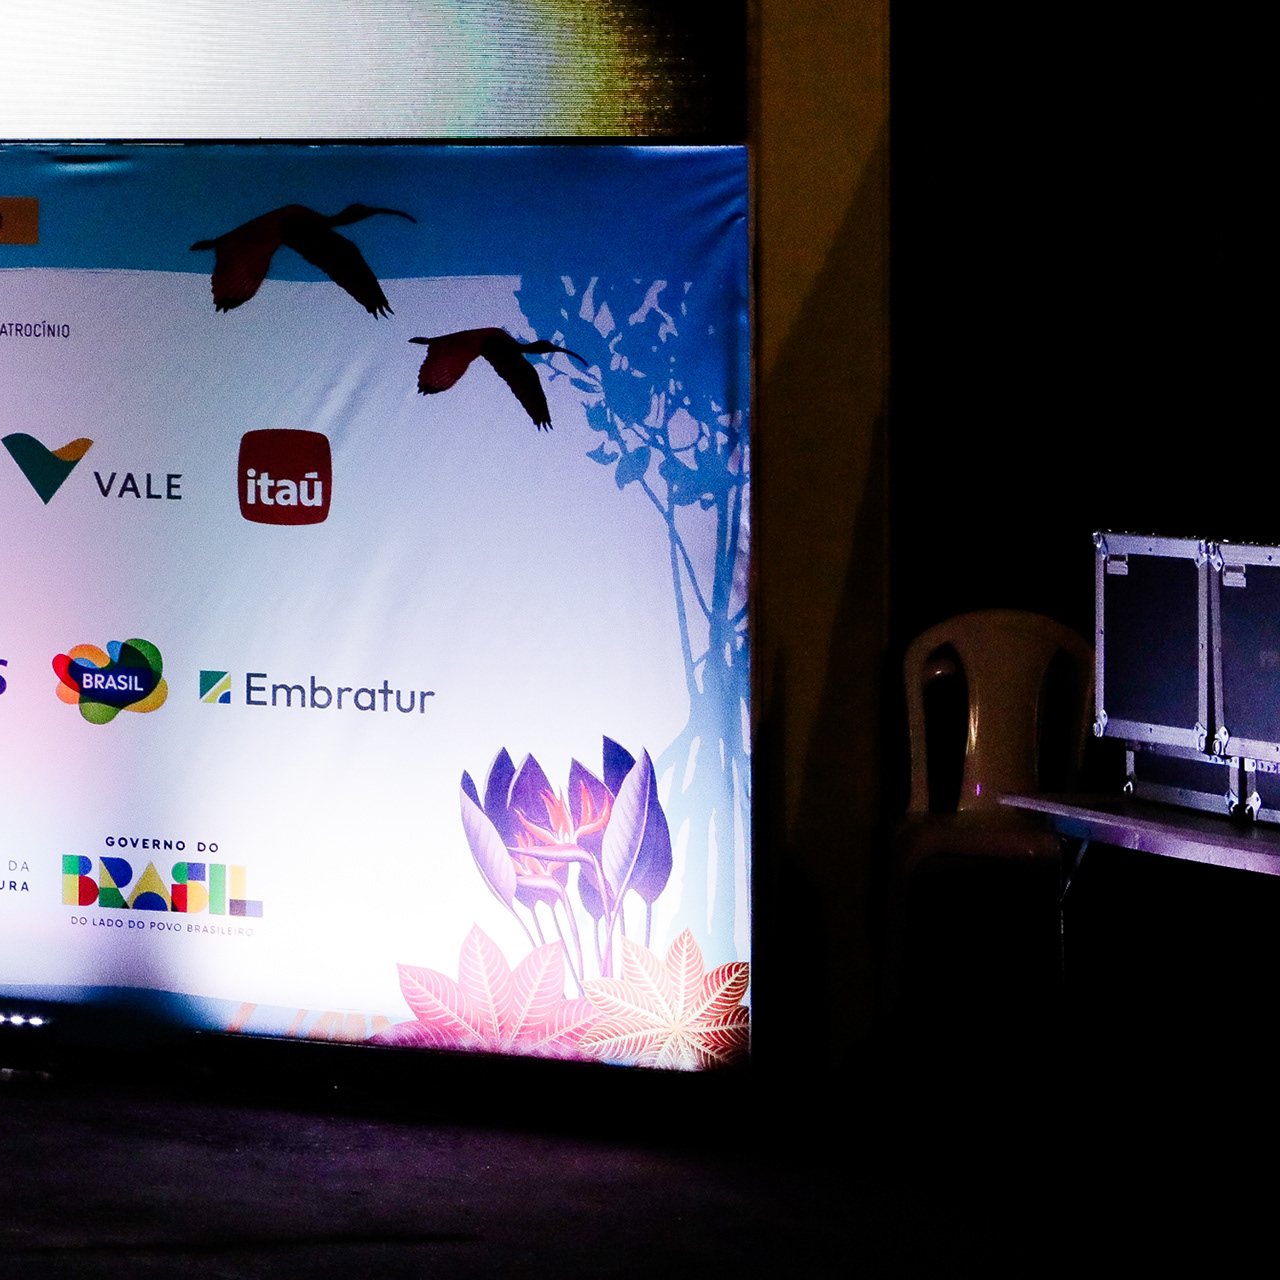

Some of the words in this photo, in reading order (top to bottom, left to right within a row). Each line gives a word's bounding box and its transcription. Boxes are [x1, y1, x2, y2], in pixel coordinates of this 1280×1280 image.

[93, 471, 183, 500] VALE
[246, 468, 323, 507] itaú
[82, 672, 145, 693] BRASIL
[246, 673, 437, 715] Embratur
[105, 836, 186, 851] GOVERNO
[197, 842, 219, 853] DO
[7, 860, 31, 873] DA
[62, 854, 264, 918] BRASIL
[71, 916, 88, 926] DO
[92, 918, 124, 929] LADO
[128, 920, 145, 930] DO
[149, 923, 182, 933] POVO
[186, 925, 254, 938] BRASILEIRO
